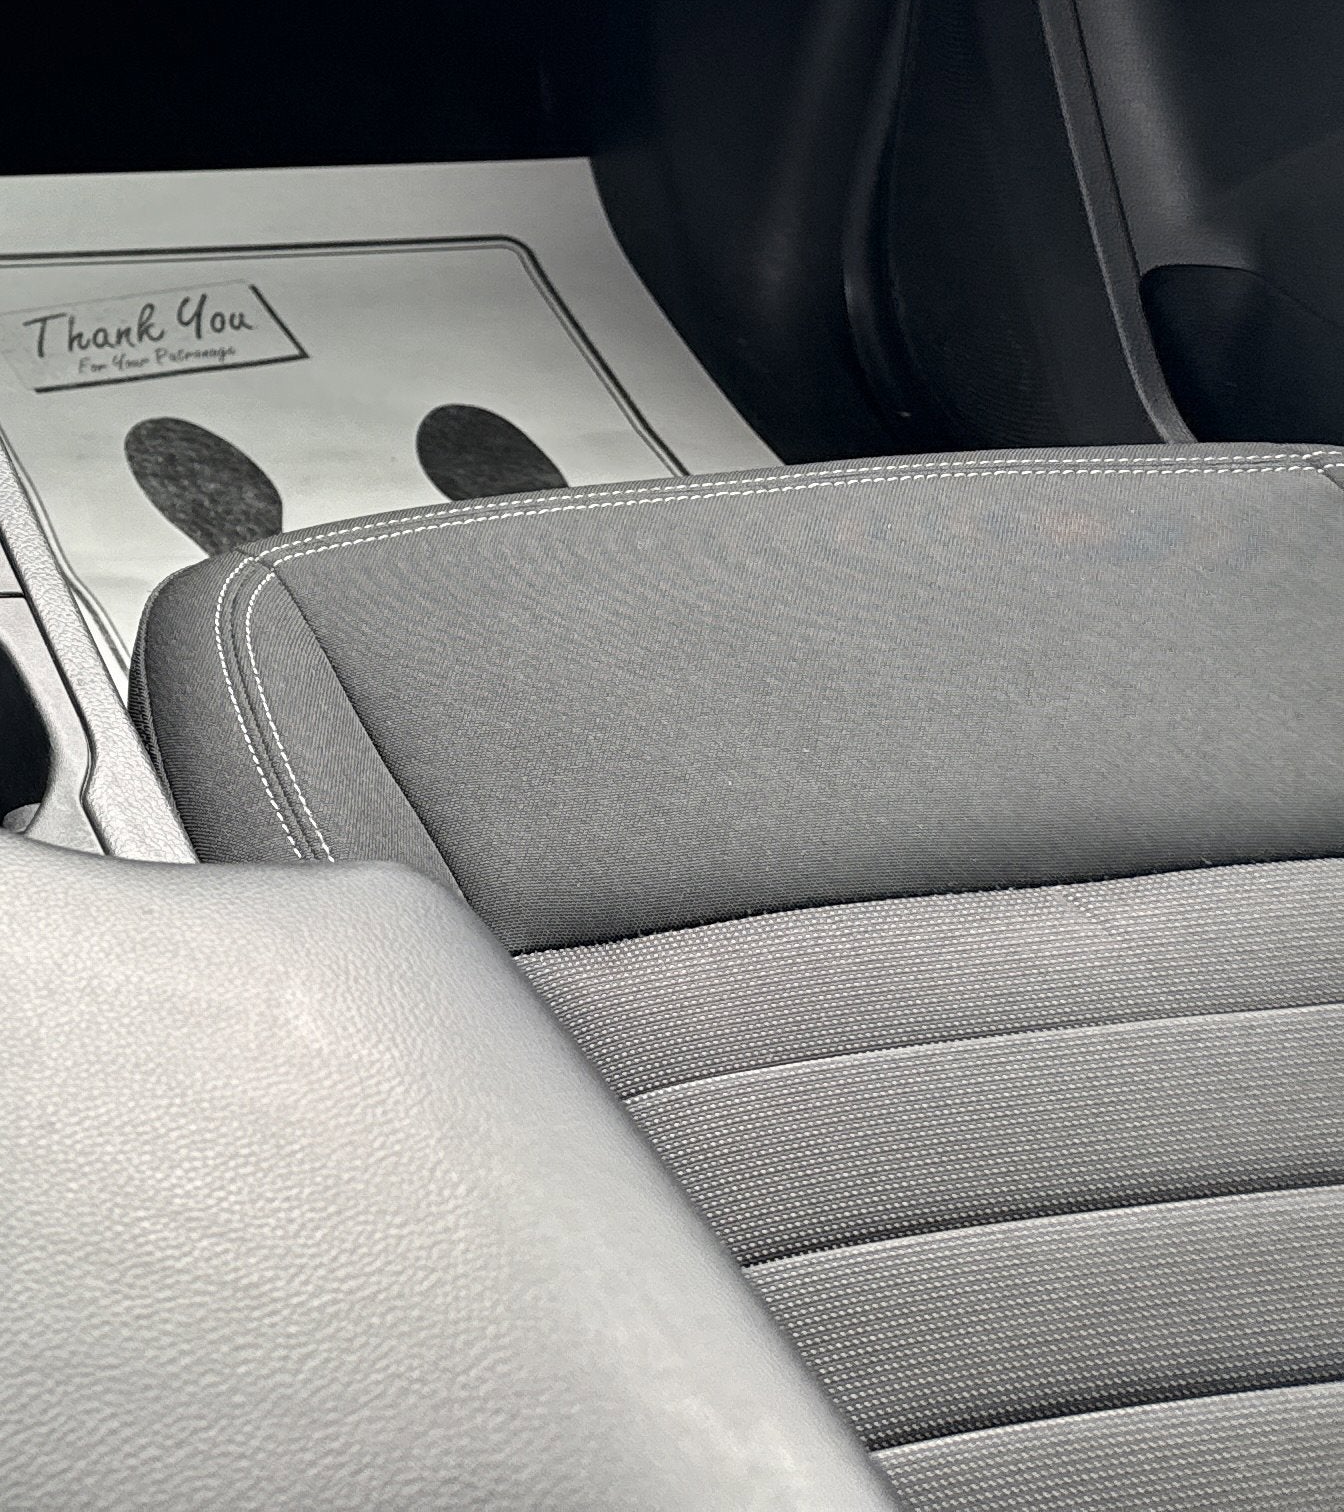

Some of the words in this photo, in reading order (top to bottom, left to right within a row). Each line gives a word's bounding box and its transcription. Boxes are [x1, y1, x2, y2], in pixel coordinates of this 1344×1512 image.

[22, 303, 164, 358] Thank
[177, 293, 253, 339] You
[78, 356, 107, 374] For
[111, 353, 149, 371] Your
